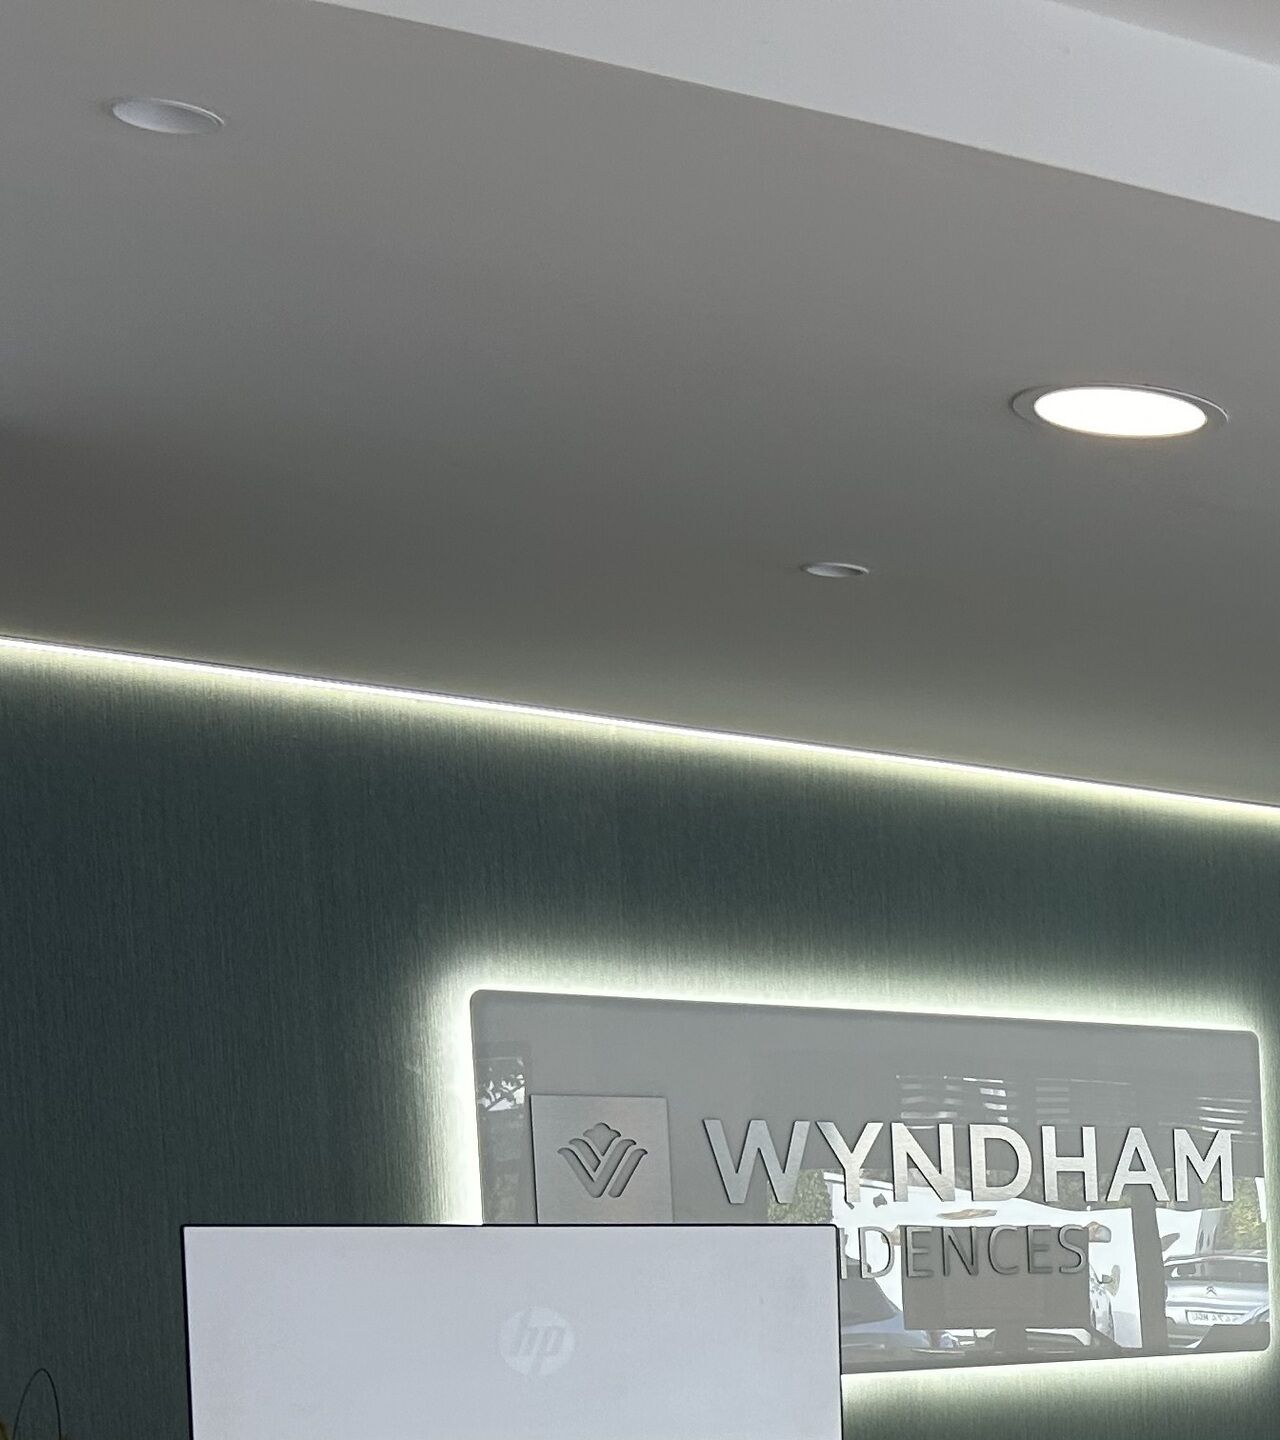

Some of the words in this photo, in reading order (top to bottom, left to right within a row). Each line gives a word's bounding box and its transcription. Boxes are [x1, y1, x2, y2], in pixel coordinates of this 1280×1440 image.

[703, 1119, 1235, 1205] WYNDHAM
[839, 1224, 1088, 1280] IDENCES
[504, 1306, 572, 1376] hp
